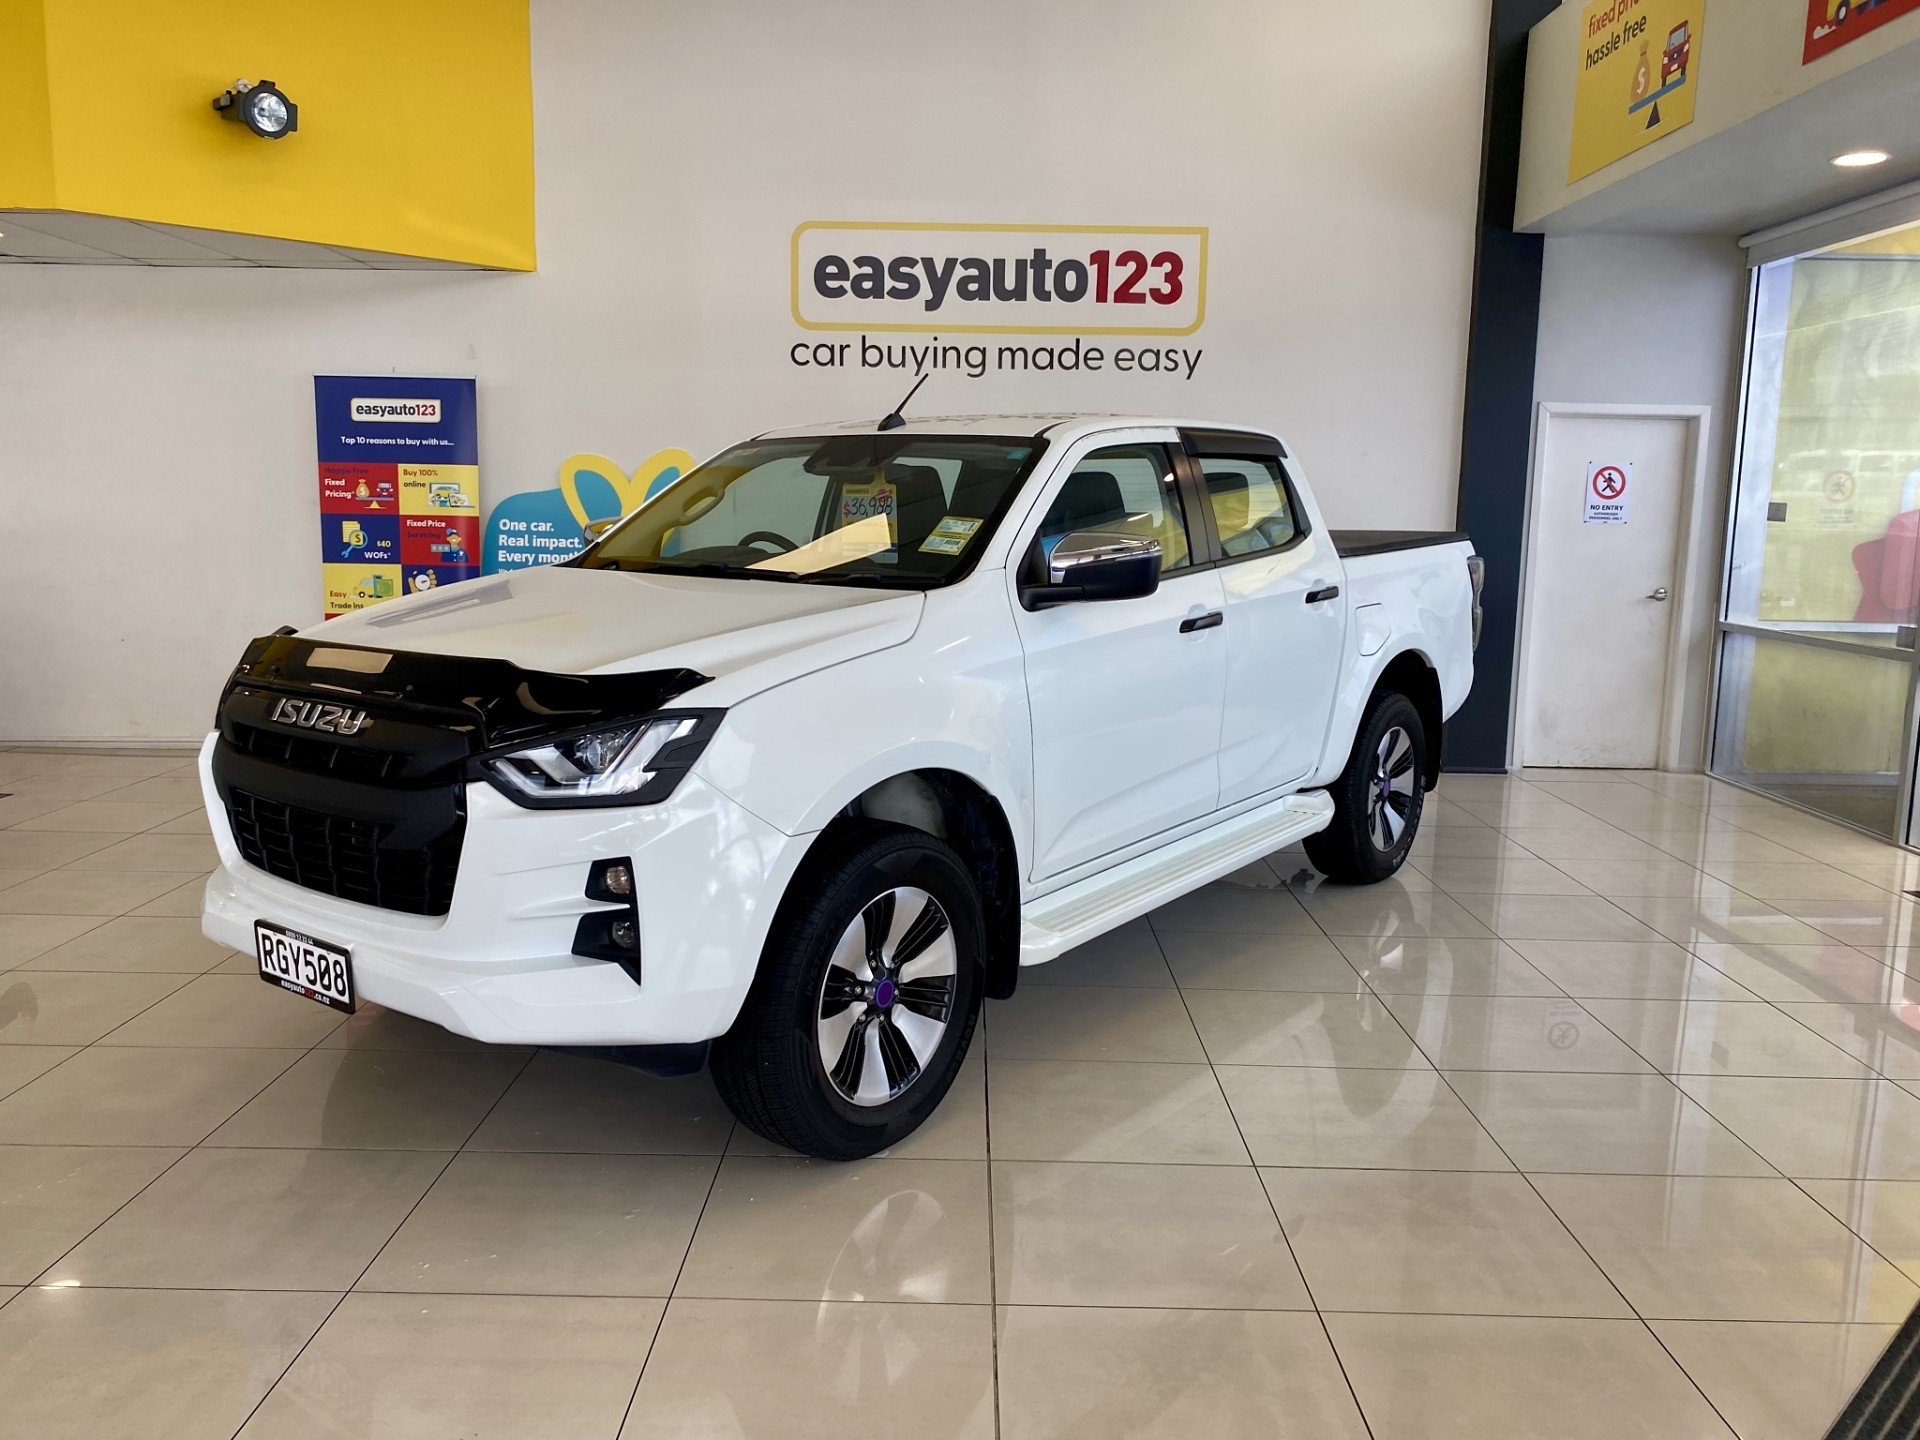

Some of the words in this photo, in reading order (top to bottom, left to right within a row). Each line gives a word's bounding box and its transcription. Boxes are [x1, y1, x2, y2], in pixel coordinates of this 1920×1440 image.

[1589, 0, 1616, 38] fixed
[1586, 32, 1620, 70] hassle
[1622, 15, 1647, 45] free
[813, 248, 1184, 312] easyauto123
[790, 341, 851, 367] car
[861, 335, 987, 378] buying
[998, 338, 1104, 371] made
[1114, 347, 1203, 380] easy
[356, 404, 436, 417] easyauto123
[341, 436, 356, 445] Top
[356, 436, 366, 444] 10
[366, 437, 396, 445] reasons
[397, 437, 405, 445] to
[405, 437, 421, 446] buy
[421, 438, 439, 446] with
[353, 467, 369, 475] Free
[403, 469, 418, 477] Buy
[324, 478, 346, 487] Fixed
[403, 480, 427, 488] online
[406, 519, 427, 528] Fixed
[427, 519, 446, 528] Price
[499, 518, 527, 531] One
[530, 521, 555, 532] car.
[407, 530, 442, 541] Servicing
[376, 540, 392, 548] $40
[498, 534, 530, 547] Real
[532, 534, 582, 550] impact.
[498, 550, 536, 566] Every
[538, 550, 579, 564] mont
[329, 590, 347, 599] Easy
[330, 601, 352, 609] Trade
[353, 602, 364, 610] Ins
[271, 698, 367, 735] ISUZU
[261, 933, 347, 997] RGY508
